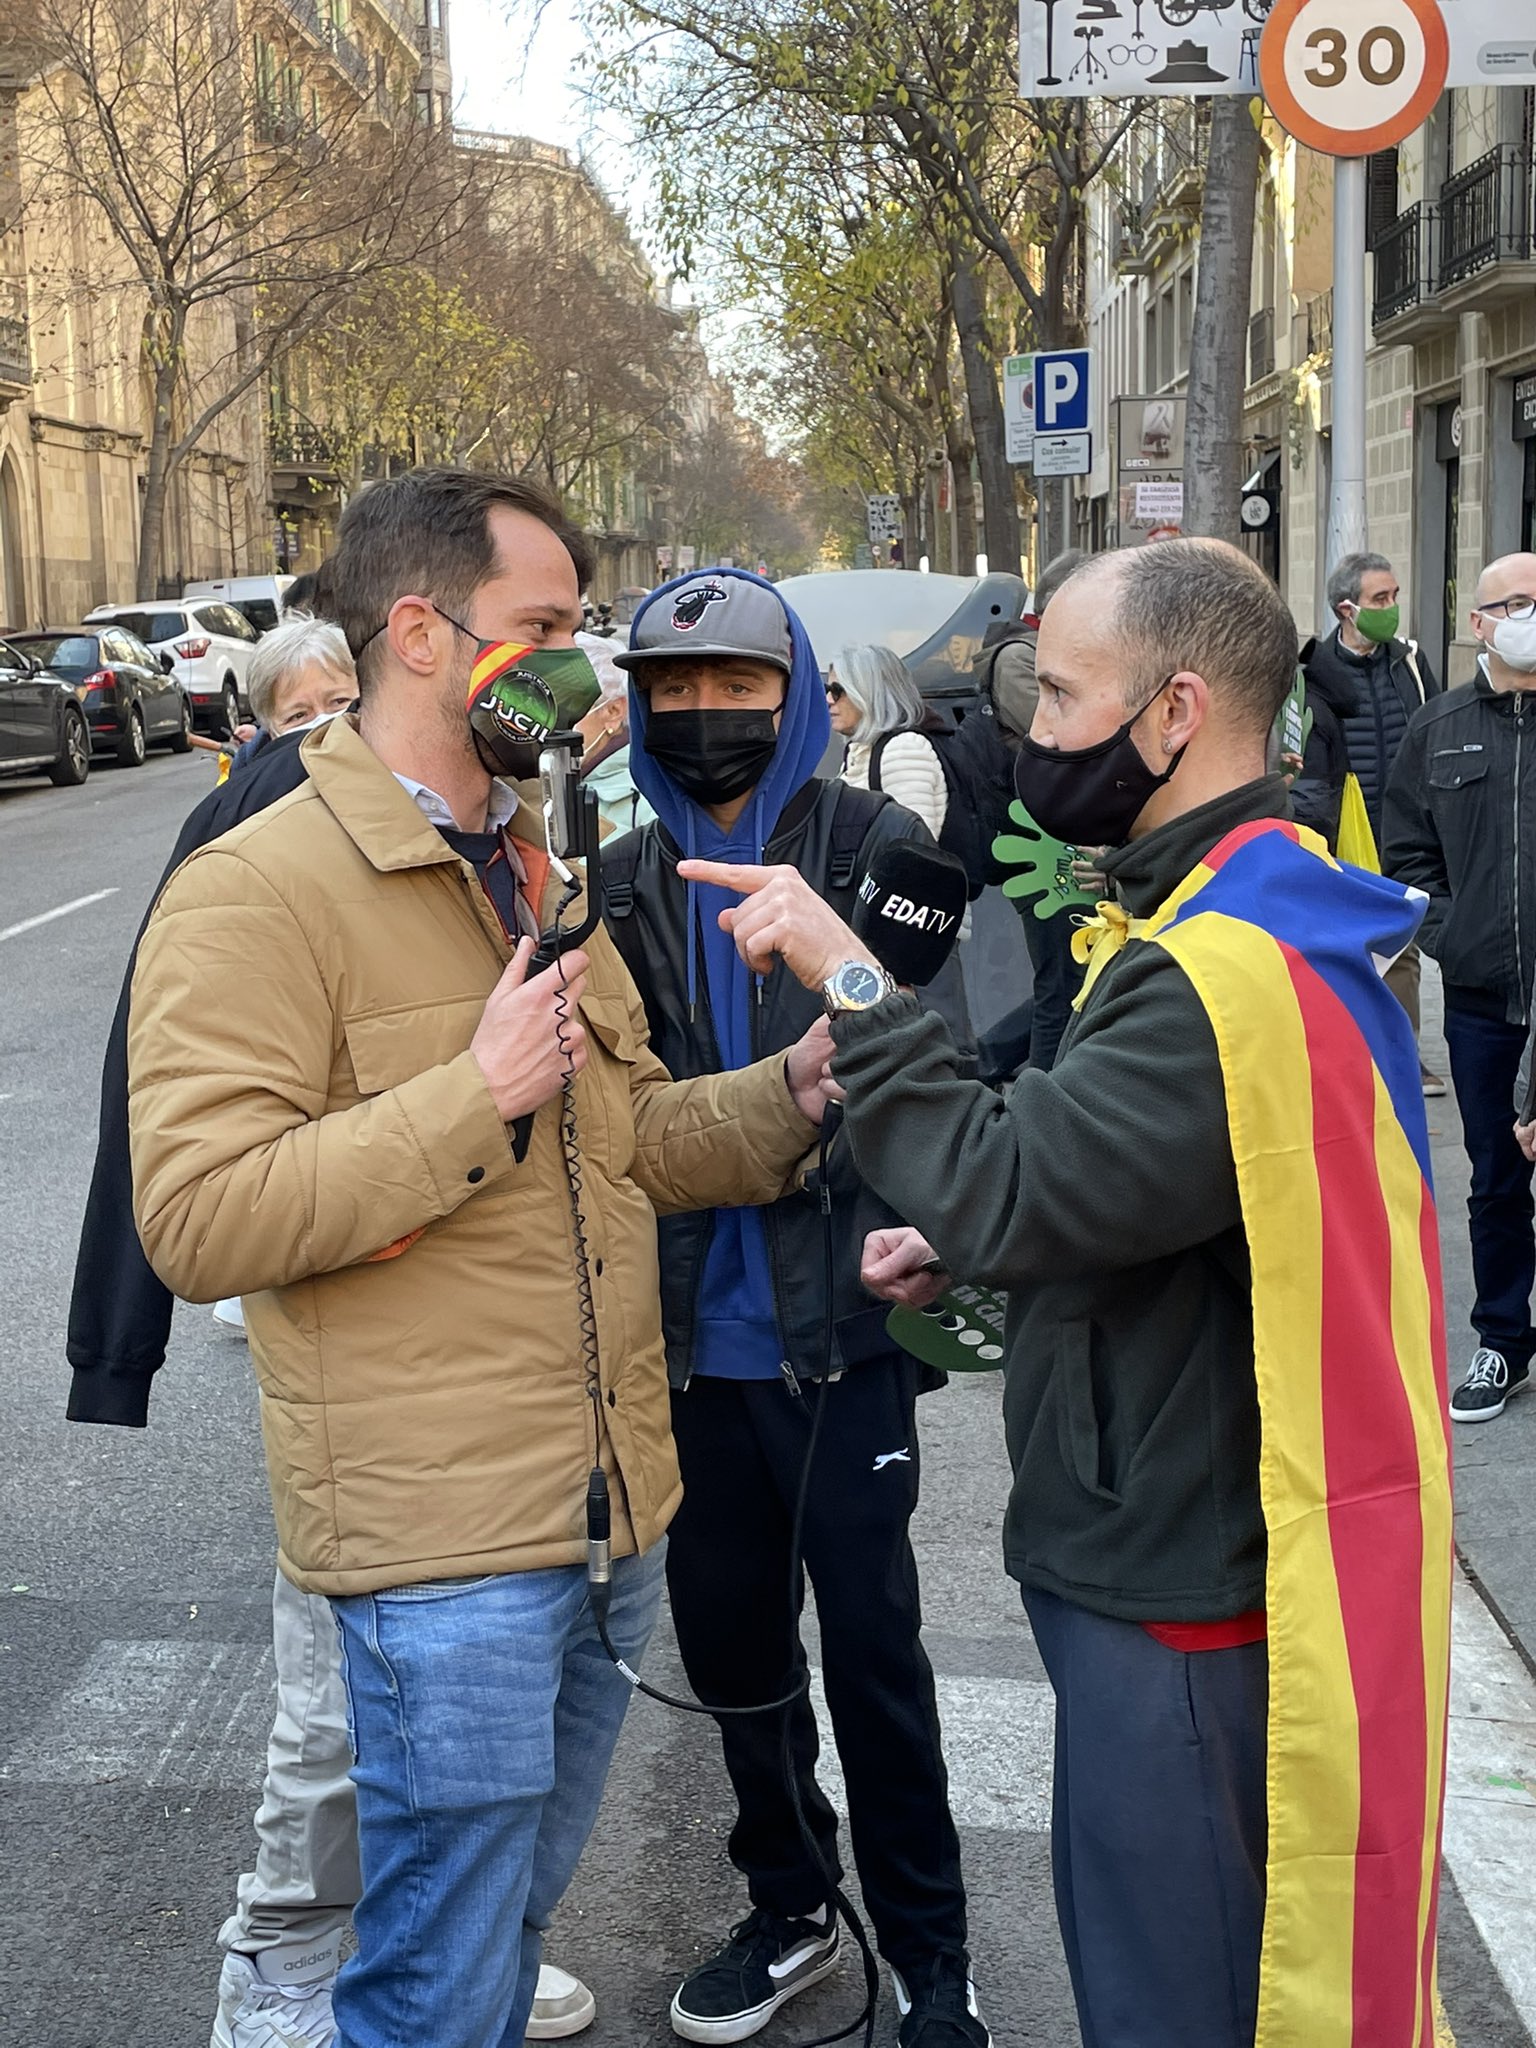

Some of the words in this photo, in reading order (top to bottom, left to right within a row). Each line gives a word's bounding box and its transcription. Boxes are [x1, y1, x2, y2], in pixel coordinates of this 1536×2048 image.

[1304, 26, 1405, 88] 30
[1044, 361, 1079, 424] P
[516, 671, 550, 696] JUSTICIA
[880, 893, 955, 934] EDATV
[283, 1948, 333, 1972] adidas
